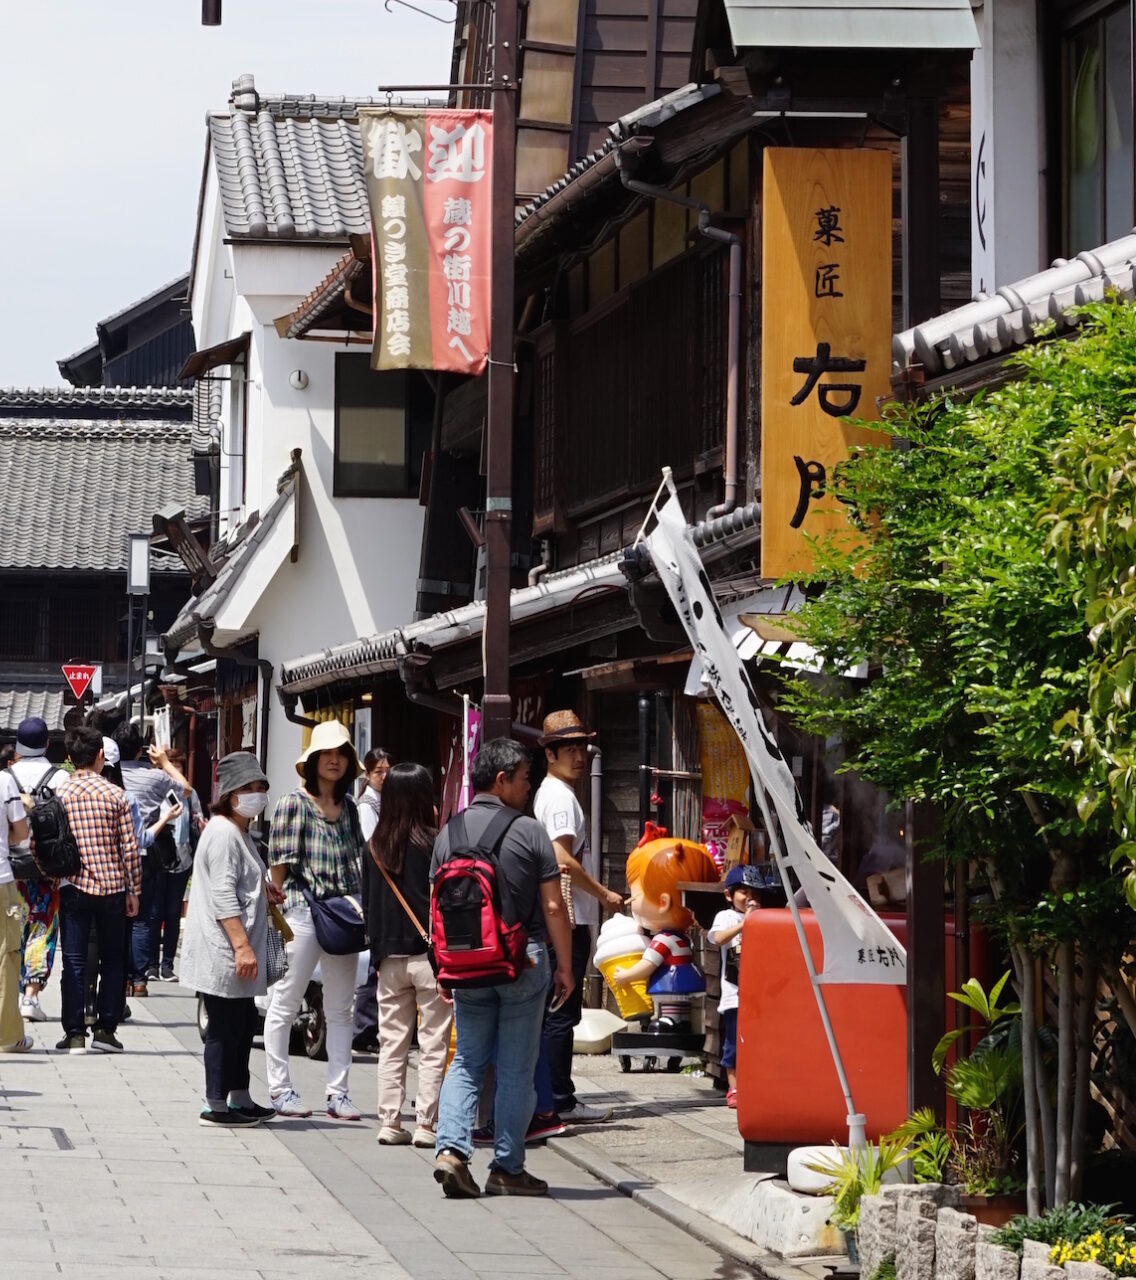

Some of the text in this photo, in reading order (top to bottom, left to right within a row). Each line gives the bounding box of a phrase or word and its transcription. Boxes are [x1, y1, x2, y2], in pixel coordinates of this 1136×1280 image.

[367, 122, 487, 184] 歓迎
[442, 197, 474, 363] 蔵の街川越へ
[813, 206, 845, 299] 菓匠
[68, 671, 90, 680] 止まれ
